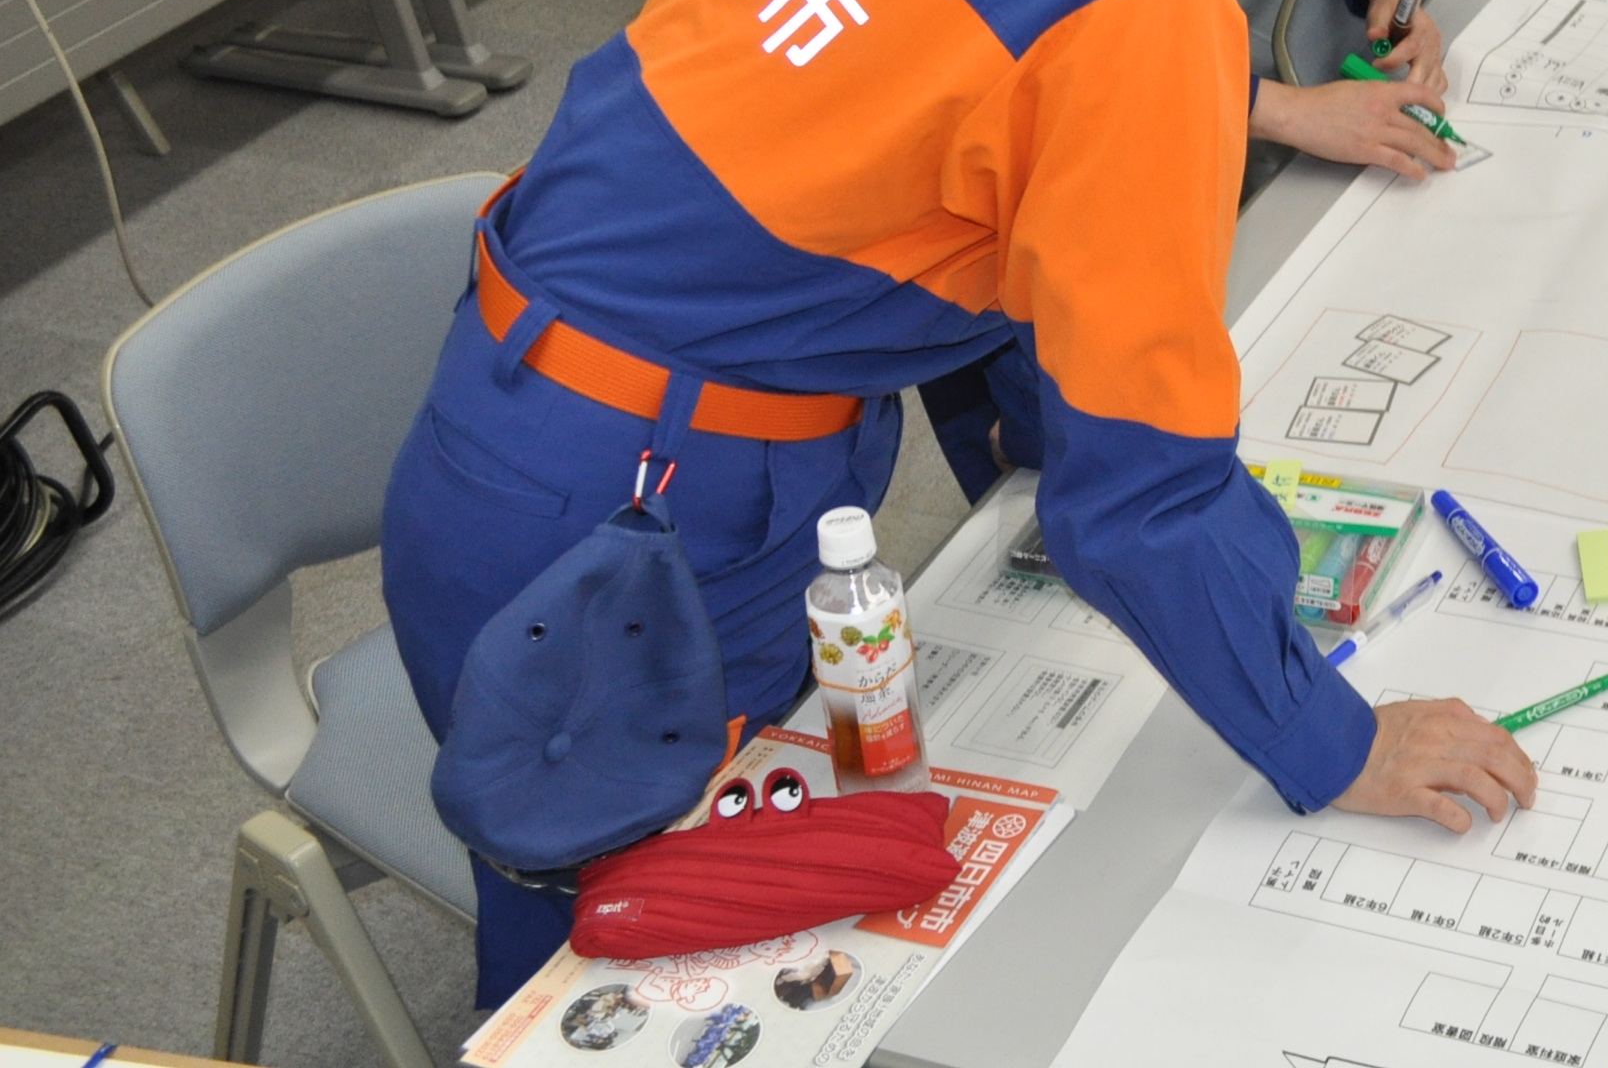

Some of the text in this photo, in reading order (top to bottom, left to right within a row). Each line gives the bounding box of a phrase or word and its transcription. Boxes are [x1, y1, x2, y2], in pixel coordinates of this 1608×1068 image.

[770, 730, 831, 752] YOKKAIC
[956, 776, 1004, 793] HINAN
[1006, 785, 1040, 799] MAP
[1561, 765, 1604, 782] 3年1組
[1515, 851, 1559, 870] 4年2組
[1565, 861, 1592, 876] 階段
[919, 839, 1010, 934] 四日市市
[1302, 868, 1323, 891] 階段
[1343, 893, 1388, 913] 6年2組
[1410, 909, 1456, 929] 6年1組
[1478, 925, 1525, 945] 5年2組
[1530, 914, 1552, 948] 多目的
[1543, 917, 1565, 949] ホール
[1431, 1021, 1475, 1043] 図書室
[1478, 1032, 1508, 1050] 階段
[1525, 1043, 1583, 1067] 家庭科室
